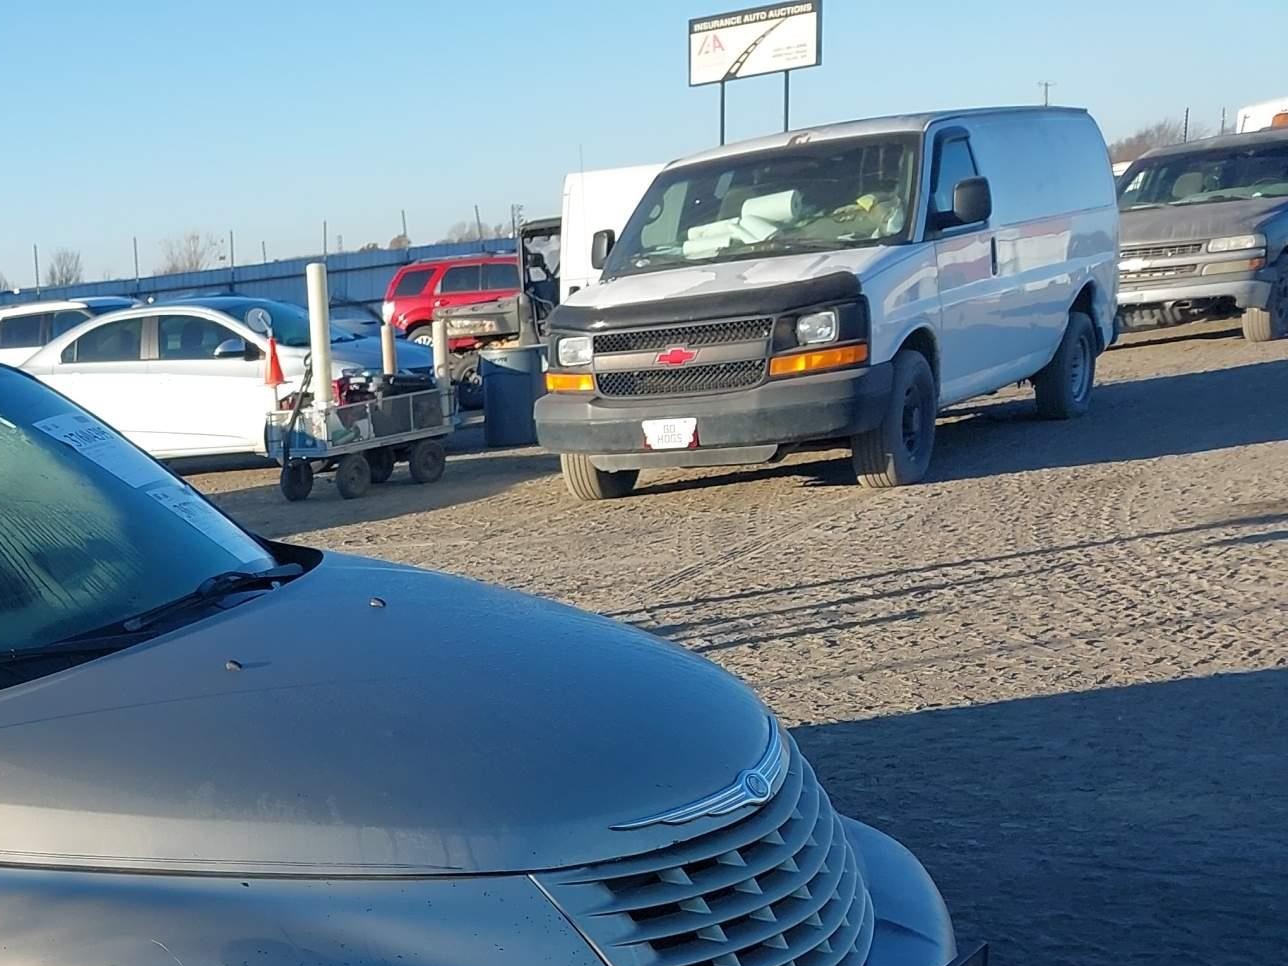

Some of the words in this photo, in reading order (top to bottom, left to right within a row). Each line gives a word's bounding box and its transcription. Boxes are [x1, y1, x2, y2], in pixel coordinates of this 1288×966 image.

[694, 15, 742, 32] INSURANCE
[743, 11, 767, 22] AUTO
[768, 3, 812, 18] AUCTIONS
